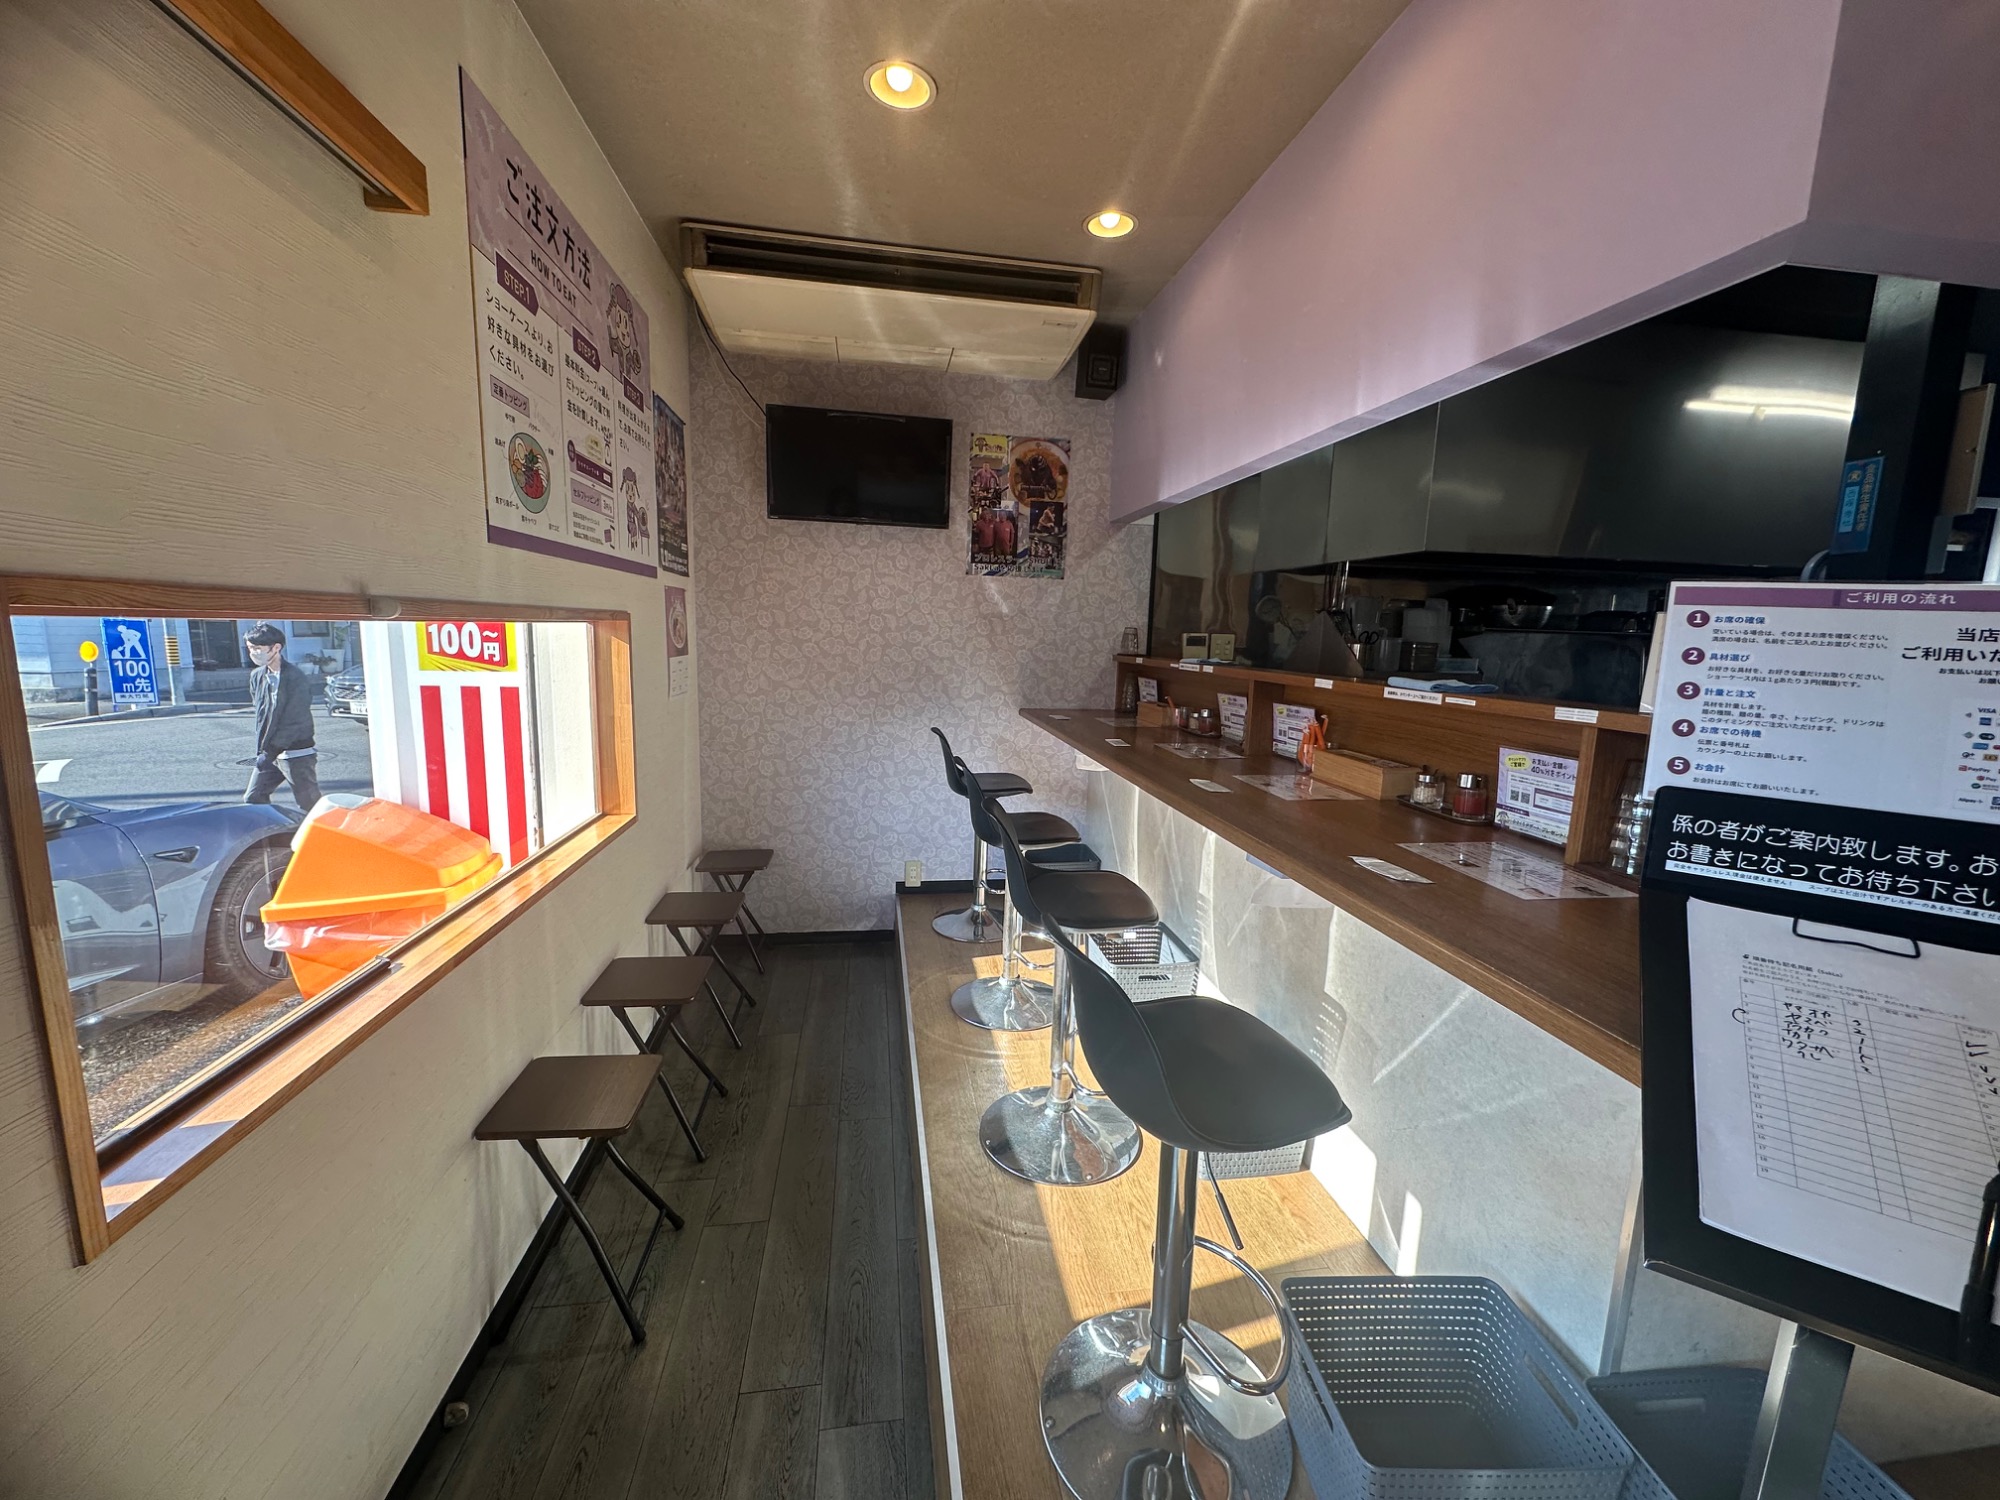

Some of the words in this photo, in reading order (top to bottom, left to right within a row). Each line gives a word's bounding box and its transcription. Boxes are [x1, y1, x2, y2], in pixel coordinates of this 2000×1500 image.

[506, 157, 592, 292] ご注文方法
[530, 249, 549, 281] HOW
[551, 271, 561, 294] TO
[563, 283, 577, 308] EAT
[504, 269, 530, 305] STEP.1
[487, 314, 554, 377] 好きな具材をお選び
[489, 344, 524, 380] ください。
[1846, 592, 1957, 605] ご利用の流れ
[1693, 613, 1702, 624] 1
[1714, 615, 1766, 625] お席の確保
[1957, 628, 2000, 643] 当店
[1687, 650, 1698, 661] 2
[1709, 653, 1750, 662] 具材選び
[114, 660, 150, 677] 100
[123, 678, 151, 692] m先
[1683, 685, 1693, 696] 3
[1704, 687, 1757, 699] 計量と注文
[1702, 701, 1767, 710] 具材を計量します。
[1678, 722, 1688, 733] 4
[1699, 726, 1762, 738] お席での待機
[1697, 738, 1750, 749] 伝票と番号札は
[1673, 759, 1684, 770] 5
[1694, 762, 1725, 773] お会計
[1671, 813, 1999, 877] 係の者がご案内致します。お
